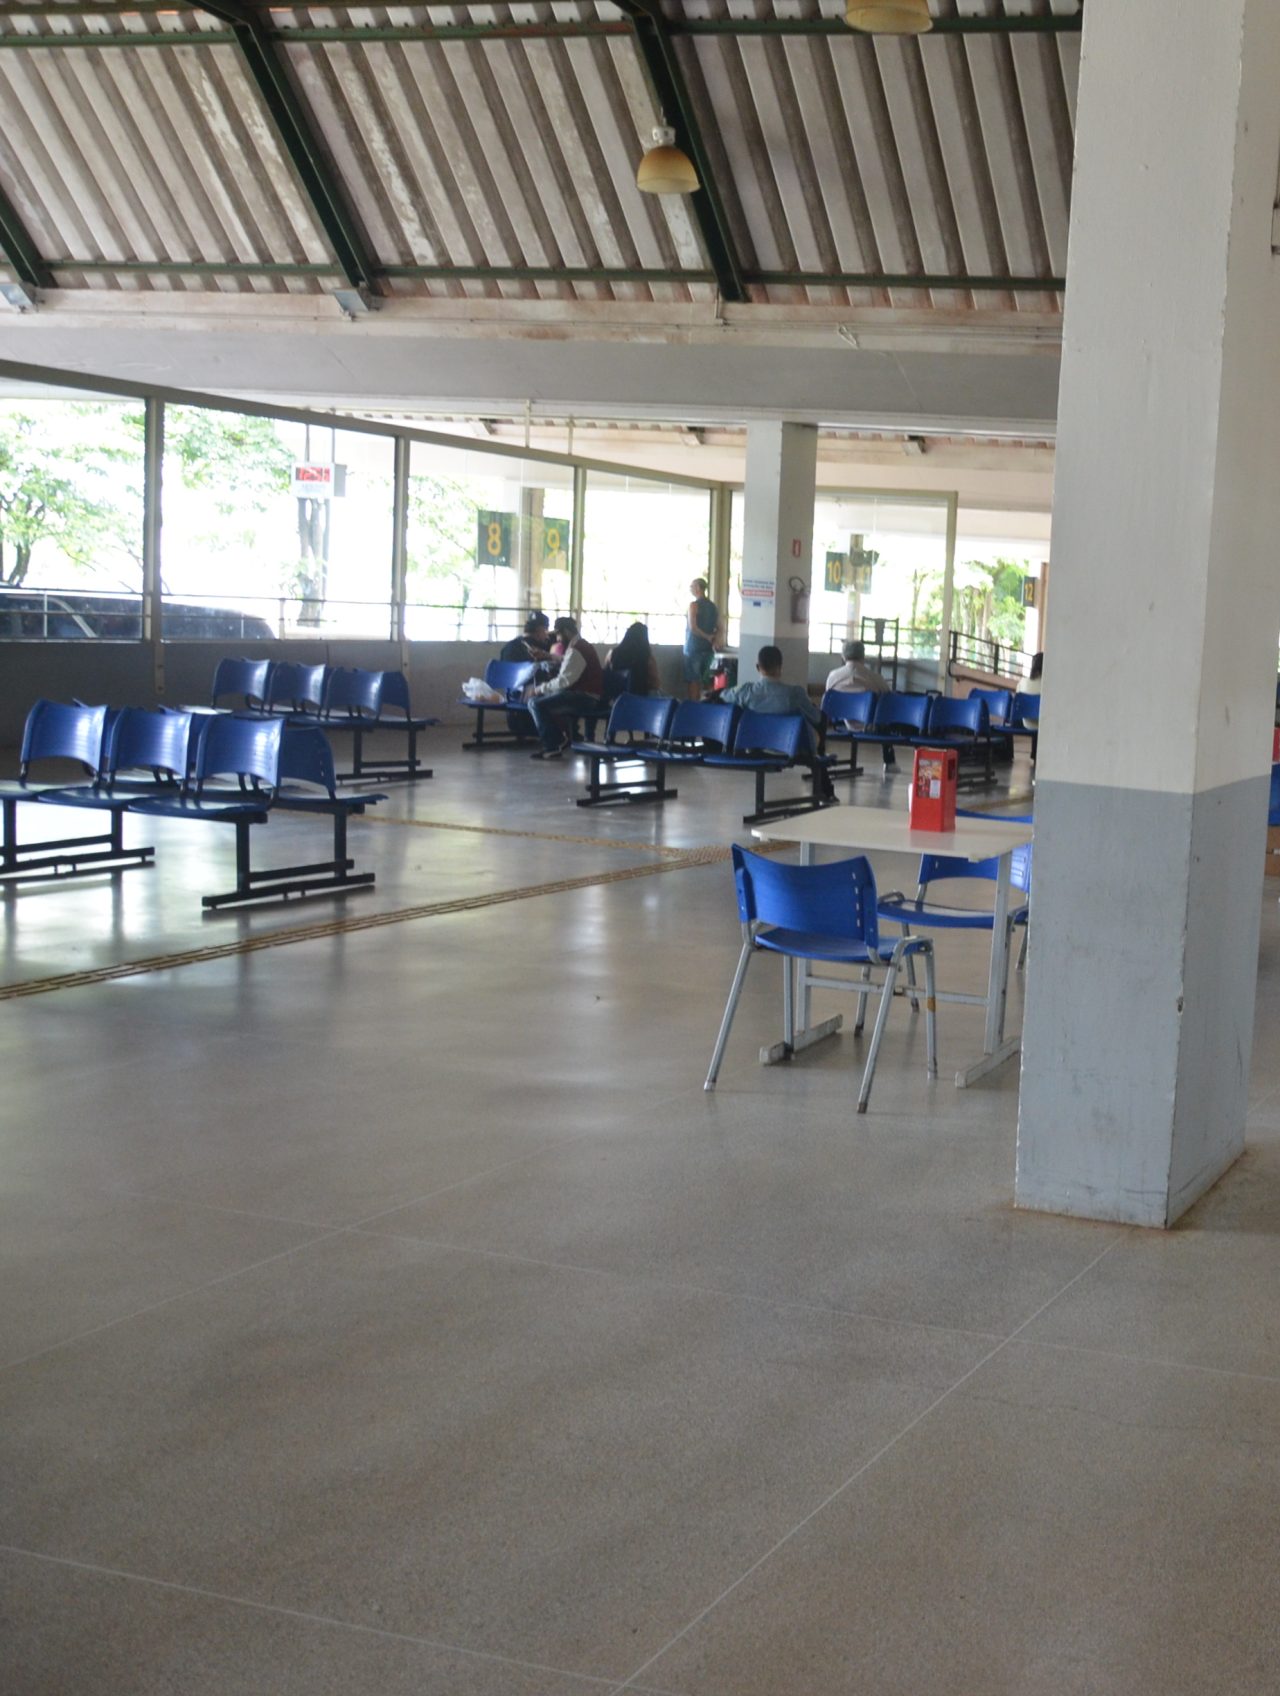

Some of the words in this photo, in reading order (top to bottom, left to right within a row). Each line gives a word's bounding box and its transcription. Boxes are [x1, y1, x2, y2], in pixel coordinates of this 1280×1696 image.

[487, 522, 501, 557] 8
[827, 561, 842, 584] 10
[1024, 583, 1034, 601] 12
